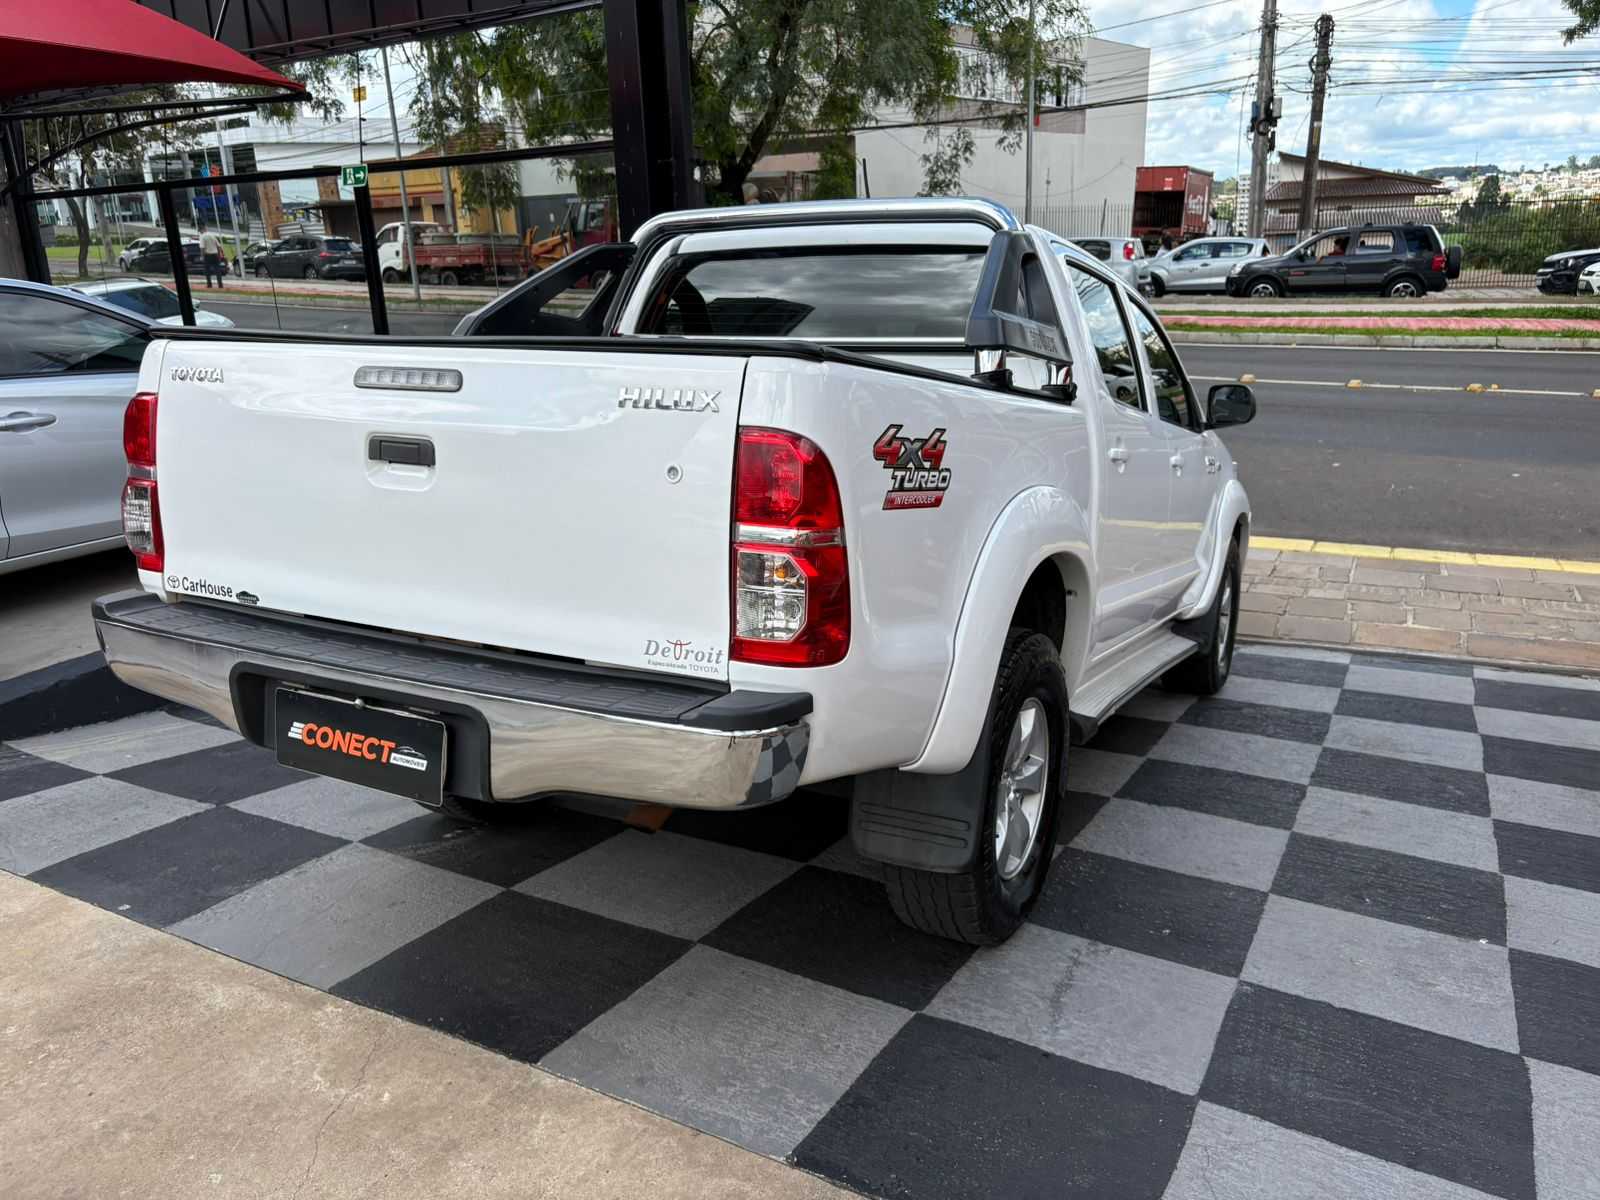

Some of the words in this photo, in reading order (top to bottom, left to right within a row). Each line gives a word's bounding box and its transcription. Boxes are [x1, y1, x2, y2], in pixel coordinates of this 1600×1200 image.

[170, 367, 224, 383] TOYOTA
[618, 386, 721, 413] HILUX
[892, 468, 951, 489] TURBO
[894, 494, 936, 505] INTERCOOLER
[181, 576, 233, 598] CarHouse
[643, 639, 725, 665] Detroit
[688, 663, 719, 674] TOYOTA
[302, 722, 396, 763] CONECT
